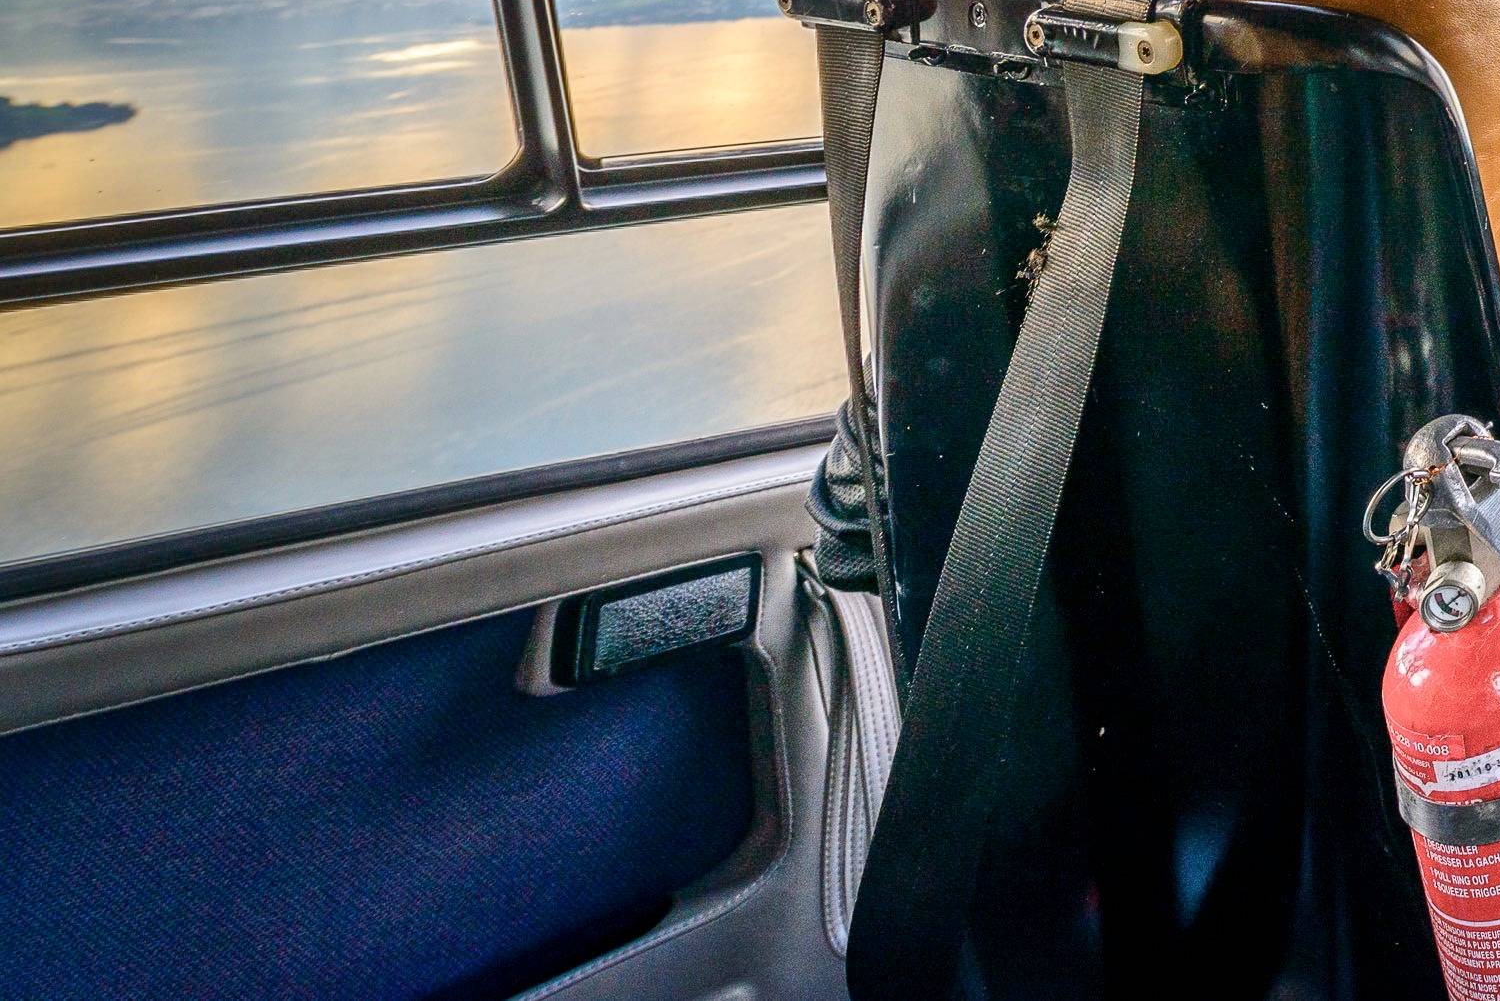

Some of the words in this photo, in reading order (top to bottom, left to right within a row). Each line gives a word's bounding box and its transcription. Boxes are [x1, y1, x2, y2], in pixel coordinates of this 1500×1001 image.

[1427, 839, 1479, 855] DEGOUPILLER
[1430, 851, 1463, 868] PRESSER
[1463, 859, 1475, 868] LA
[1433, 868, 1451, 883] PULL
[1451, 874, 1471, 886] RING
[1472, 874, 1489, 886] OUT
[1436, 881, 1470, 898] SQUEEZE
[1473, 941, 1491, 950] PLUS
[1467, 949, 1495, 959] FUMEES
[1478, 984, 1498, 994] MORE
